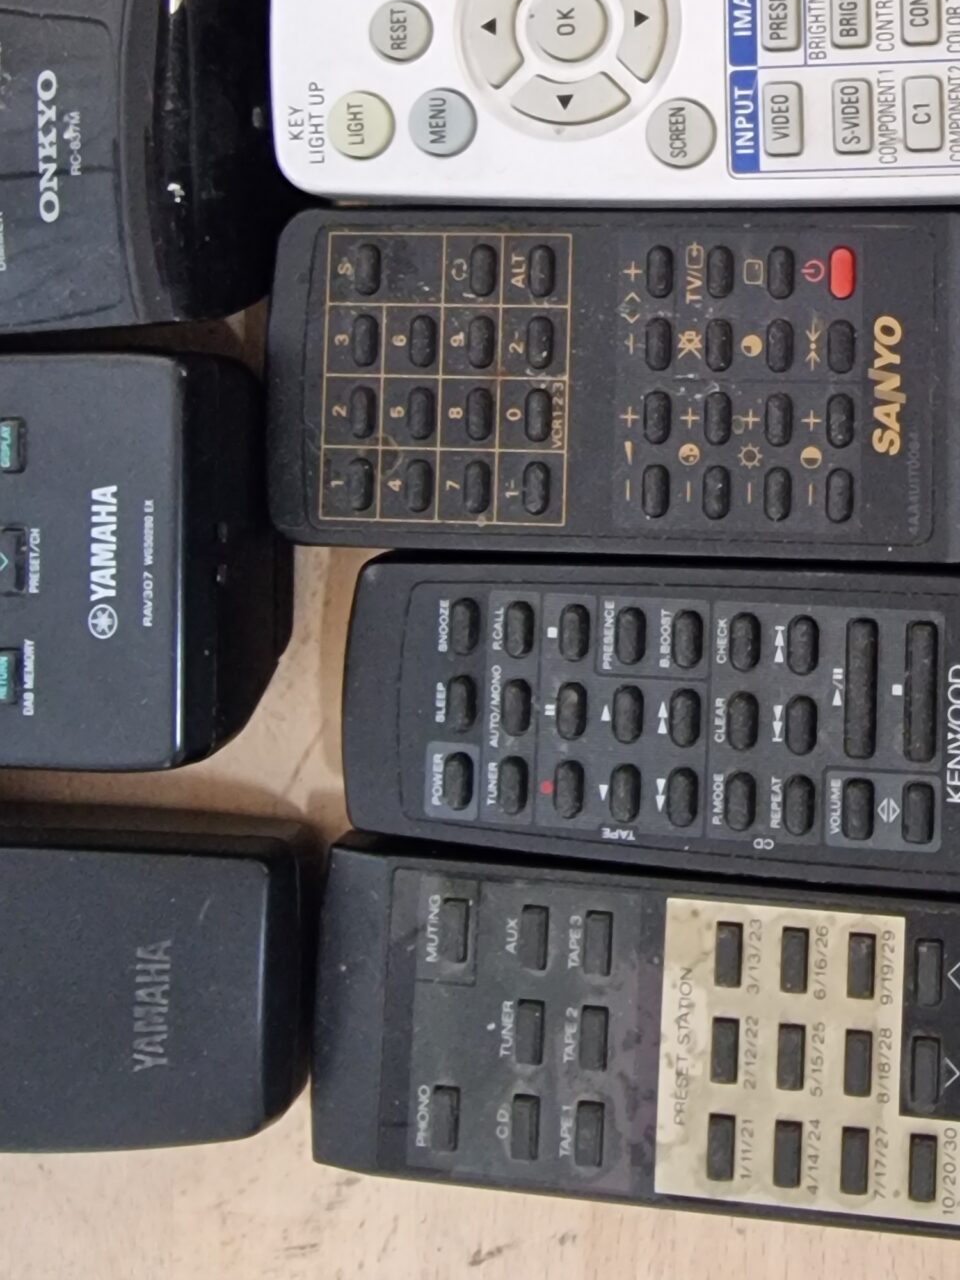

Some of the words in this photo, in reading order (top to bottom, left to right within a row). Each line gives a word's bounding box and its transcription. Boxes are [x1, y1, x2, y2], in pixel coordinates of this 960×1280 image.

[390, 9, 407, 50] RESET
[557, 8, 575, 35] OK
[309, 82, 324, 105] UP
[771, 95, 789, 140] VIDEO
[840, 86, 860, 144] S-VIDEO
[912, 104, 931, 124] C1
[288, 107, 304, 140] KEY
[309, 113, 324, 163] LIGHT
[347, 104, 364, 145] LIGHT
[429, 98, 446, 143] MENU
[669, 107, 687, 158] SCREEN
[735, 87, 754, 153] INPUT
[37, 70, 59, 222] ONKYO
[511, 254, 525, 288] ALT
[869, 316, 905, 455] SANYO
[90, 485, 117, 601] YAMAHA
[438, 600, 449, 652] SNOOZE
[603, 601, 615, 669] PRESENCE
[716, 619, 727, 664] CHECK
[435, 682, 446, 722] SLEEP
[490, 665, 501, 747] AUTO/MONO
[714, 698, 725, 742] CLEAR
[432, 754, 443, 805] POWER
[487, 762, 500, 805] TUNER
[770, 777, 782, 828] REPEAT
[830, 779, 841, 834] VOLUME
[602, 828, 635, 840] TAPE
[426, 895, 441, 962] MUTING
[132, 940, 171, 1072] YAMAHA
[500, 1001, 514, 1056] TUNER
[676, 968, 694, 1045] STATION
[673, 1055, 690, 1126] PRESET
[740, 1120, 754, 1179] 1/11/21
[872, 1126, 888, 1198] 7/17/27
[941, 1128, 957, 1214] 10/20/30
